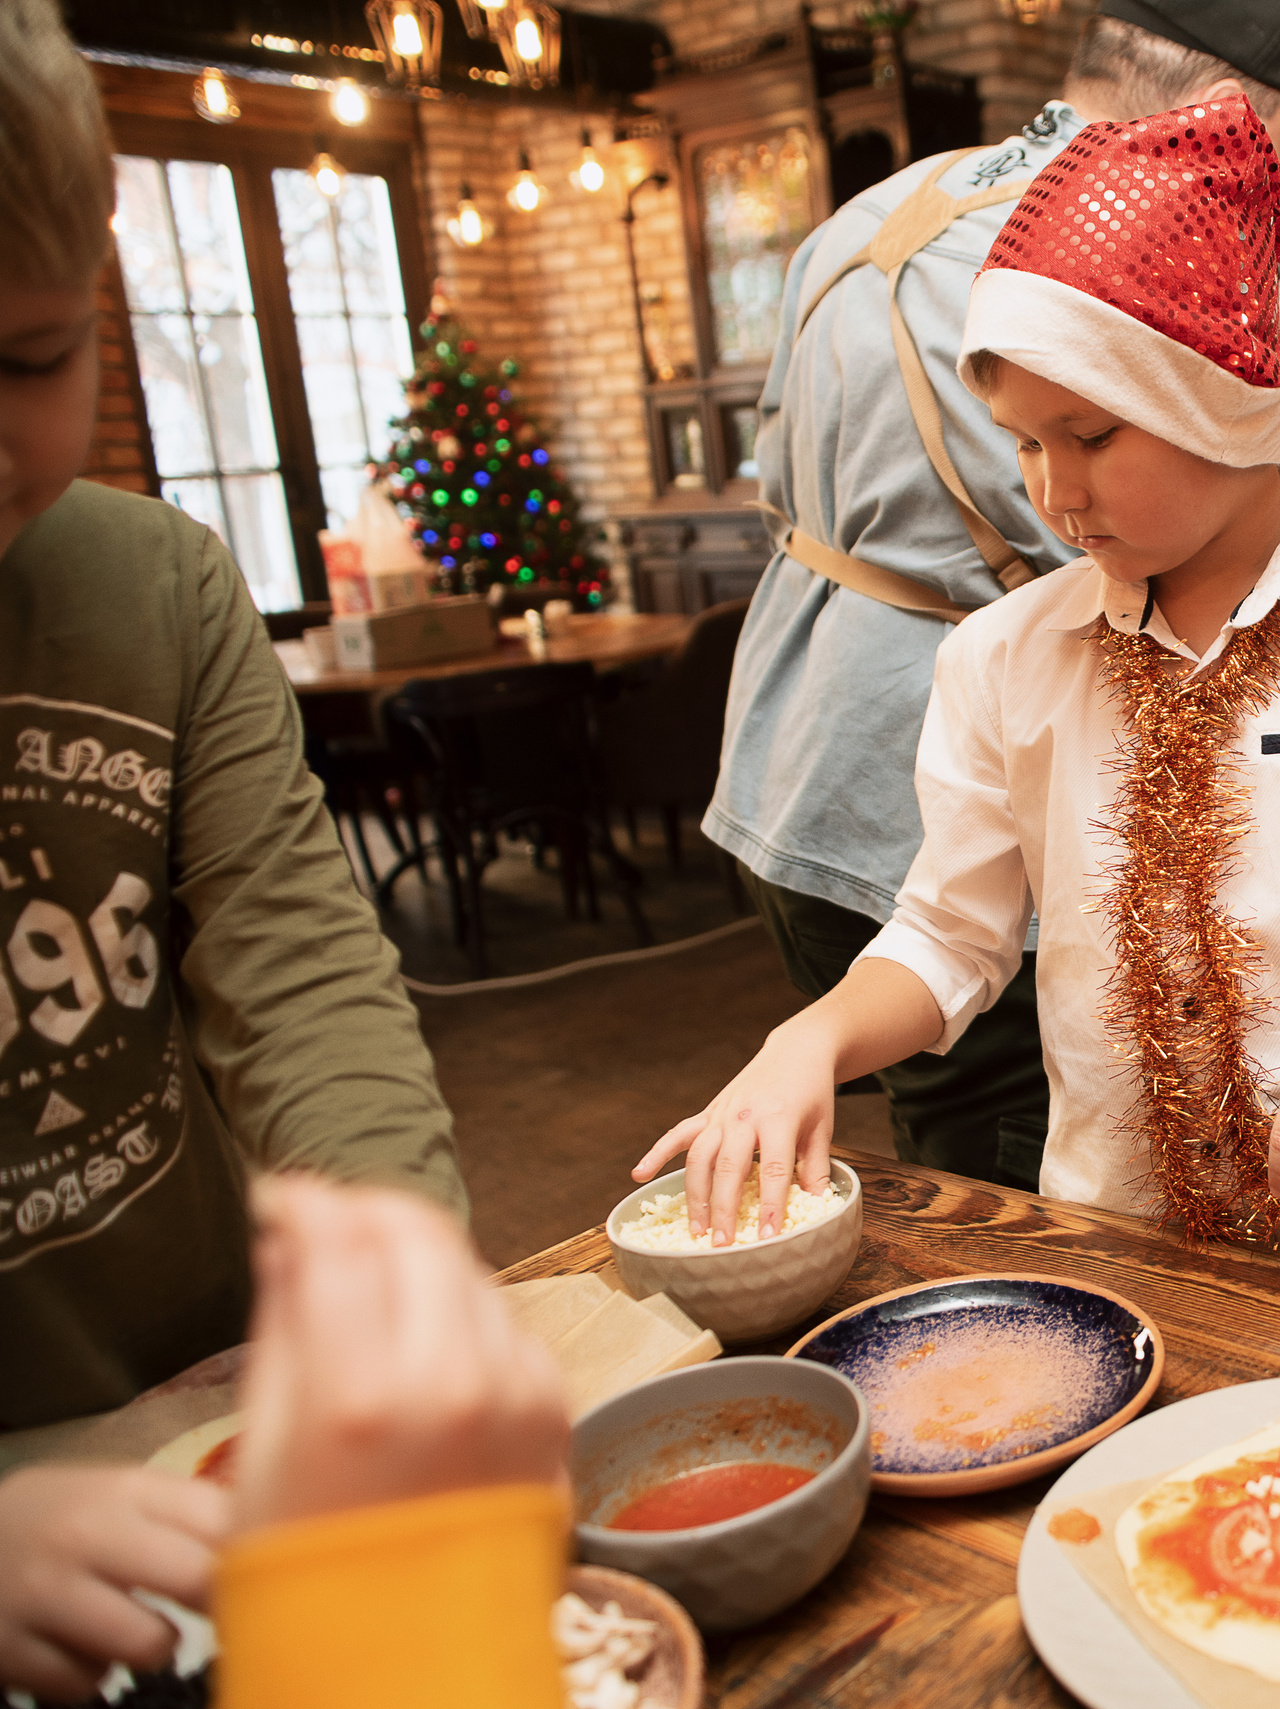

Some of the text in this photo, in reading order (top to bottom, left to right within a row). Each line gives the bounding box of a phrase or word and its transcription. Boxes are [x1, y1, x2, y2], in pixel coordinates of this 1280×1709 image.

[62, 790, 161, 837] APPAREL
[0, 871, 158, 1052] 96
[88, 1092, 155, 1145] BRAND
